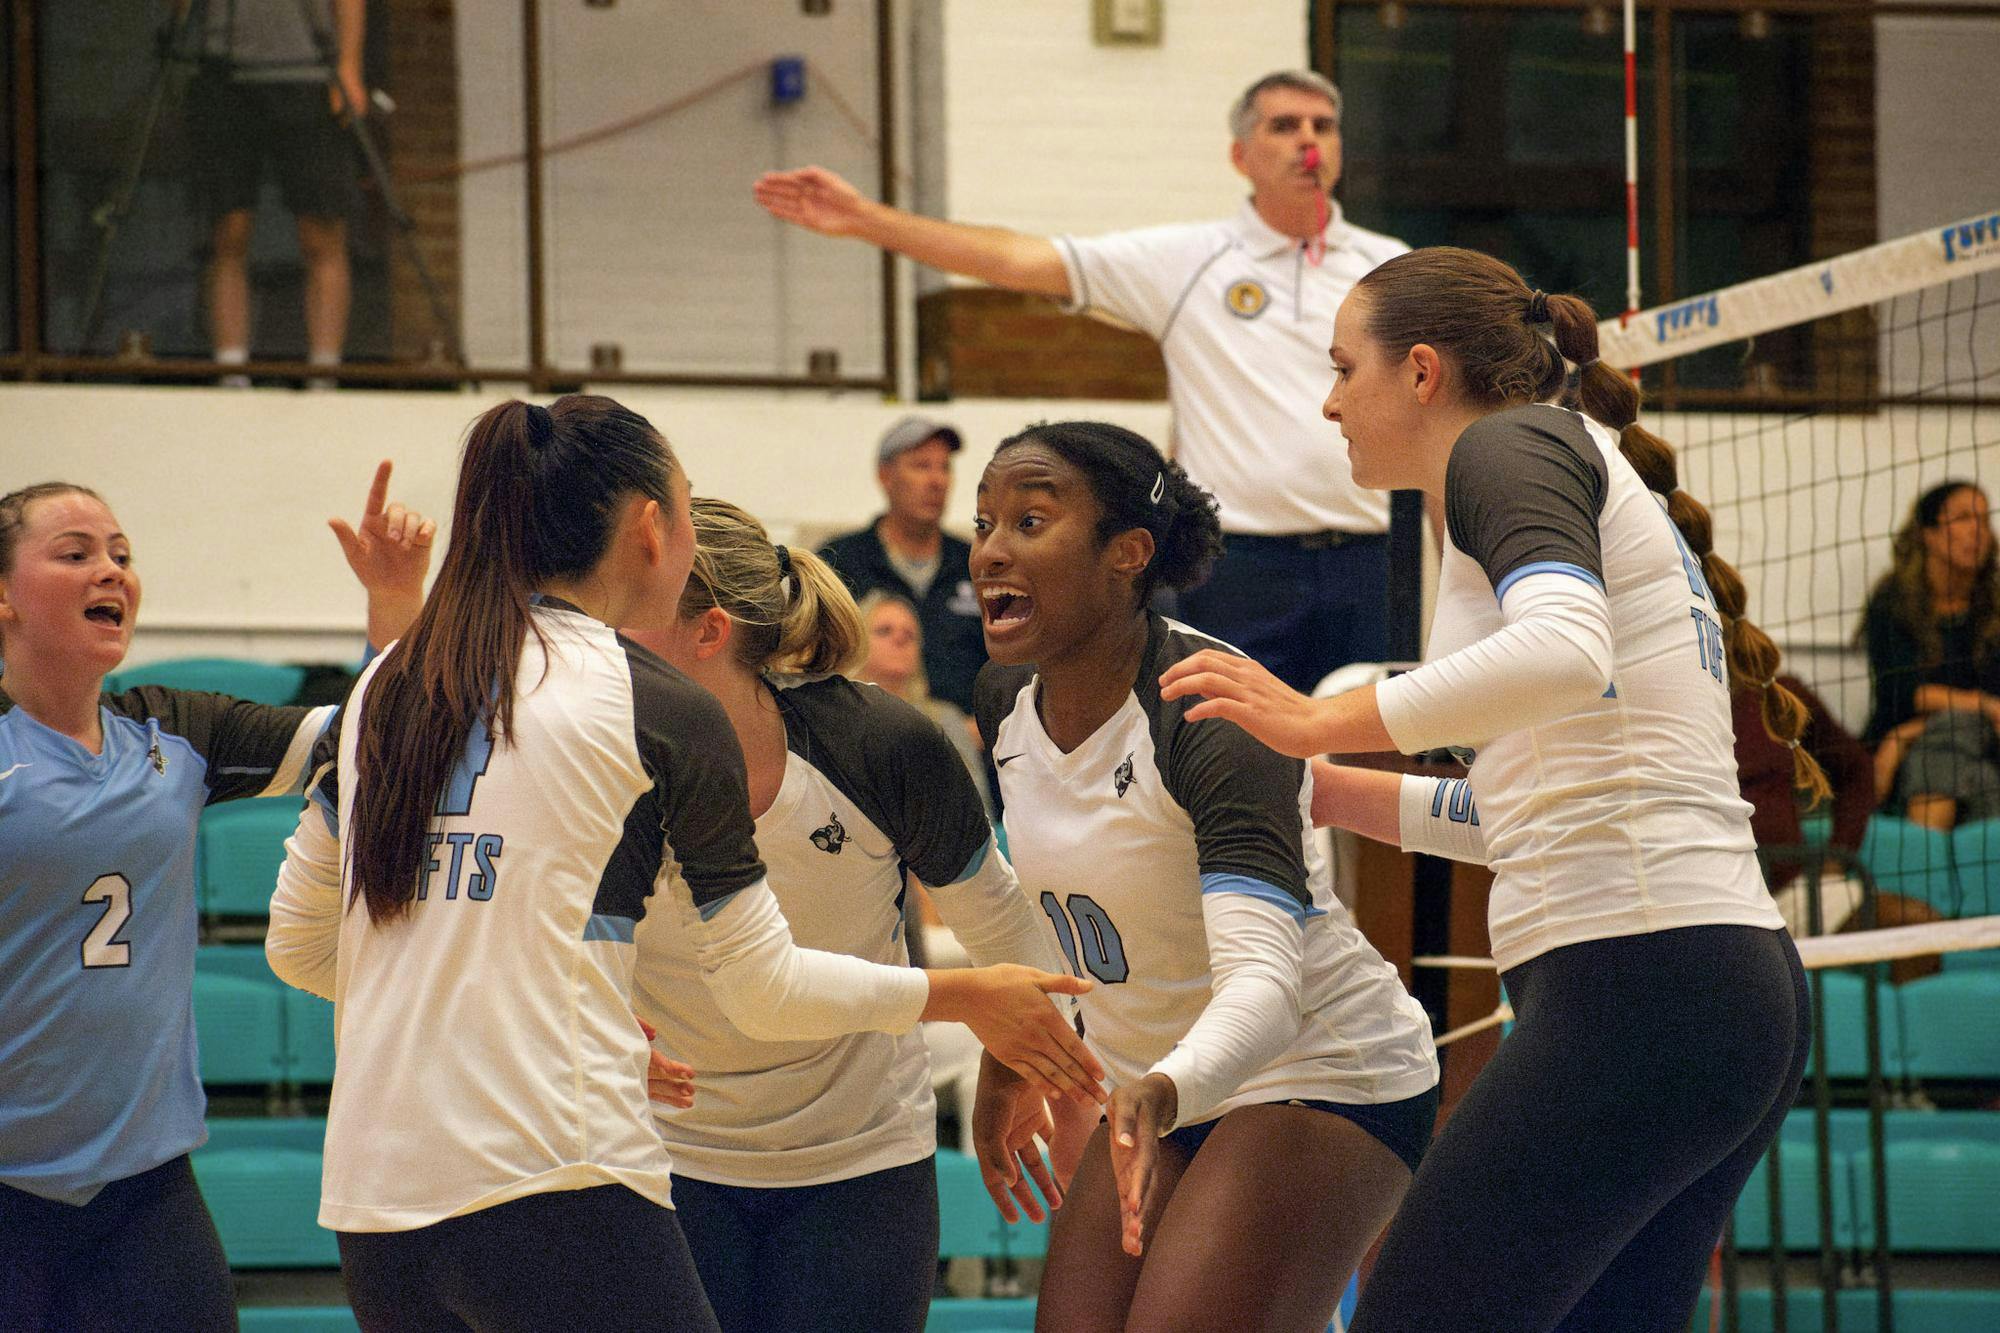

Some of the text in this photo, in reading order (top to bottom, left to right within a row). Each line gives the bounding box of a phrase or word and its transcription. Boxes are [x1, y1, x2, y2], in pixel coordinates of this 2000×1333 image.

[418, 832, 503, 901] FTS
[81, 872, 132, 969] 2
[1040, 891, 1129, 984] 10
